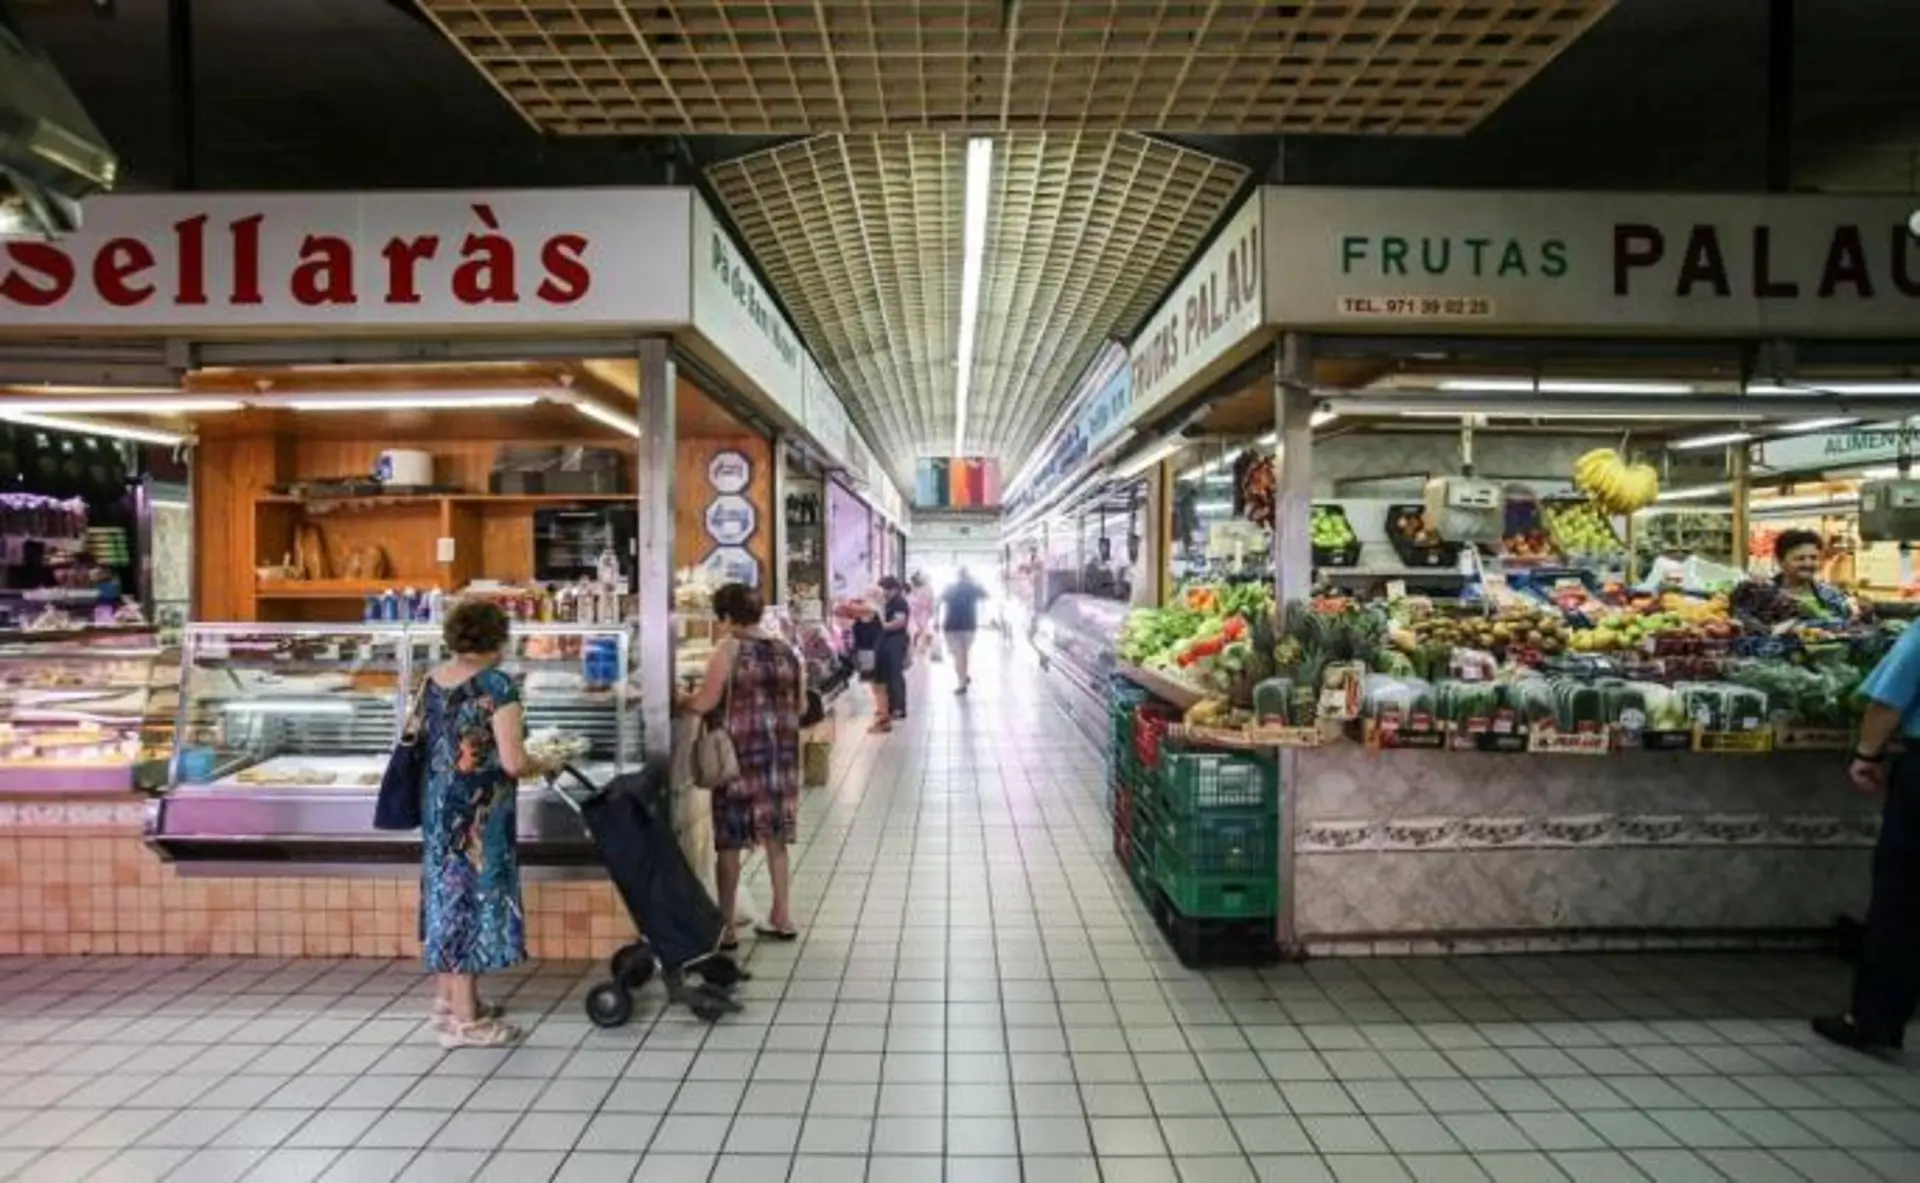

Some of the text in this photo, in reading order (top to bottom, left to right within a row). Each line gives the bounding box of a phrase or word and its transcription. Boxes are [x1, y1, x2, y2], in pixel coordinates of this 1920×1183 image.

[0, 203, 591, 306] Sellaràs
[1185, 225, 1257, 356] PALAU
[1342, 224, 1920, 298] FRUTAS PALAU
[1386, 299, 1413, 314] 971
